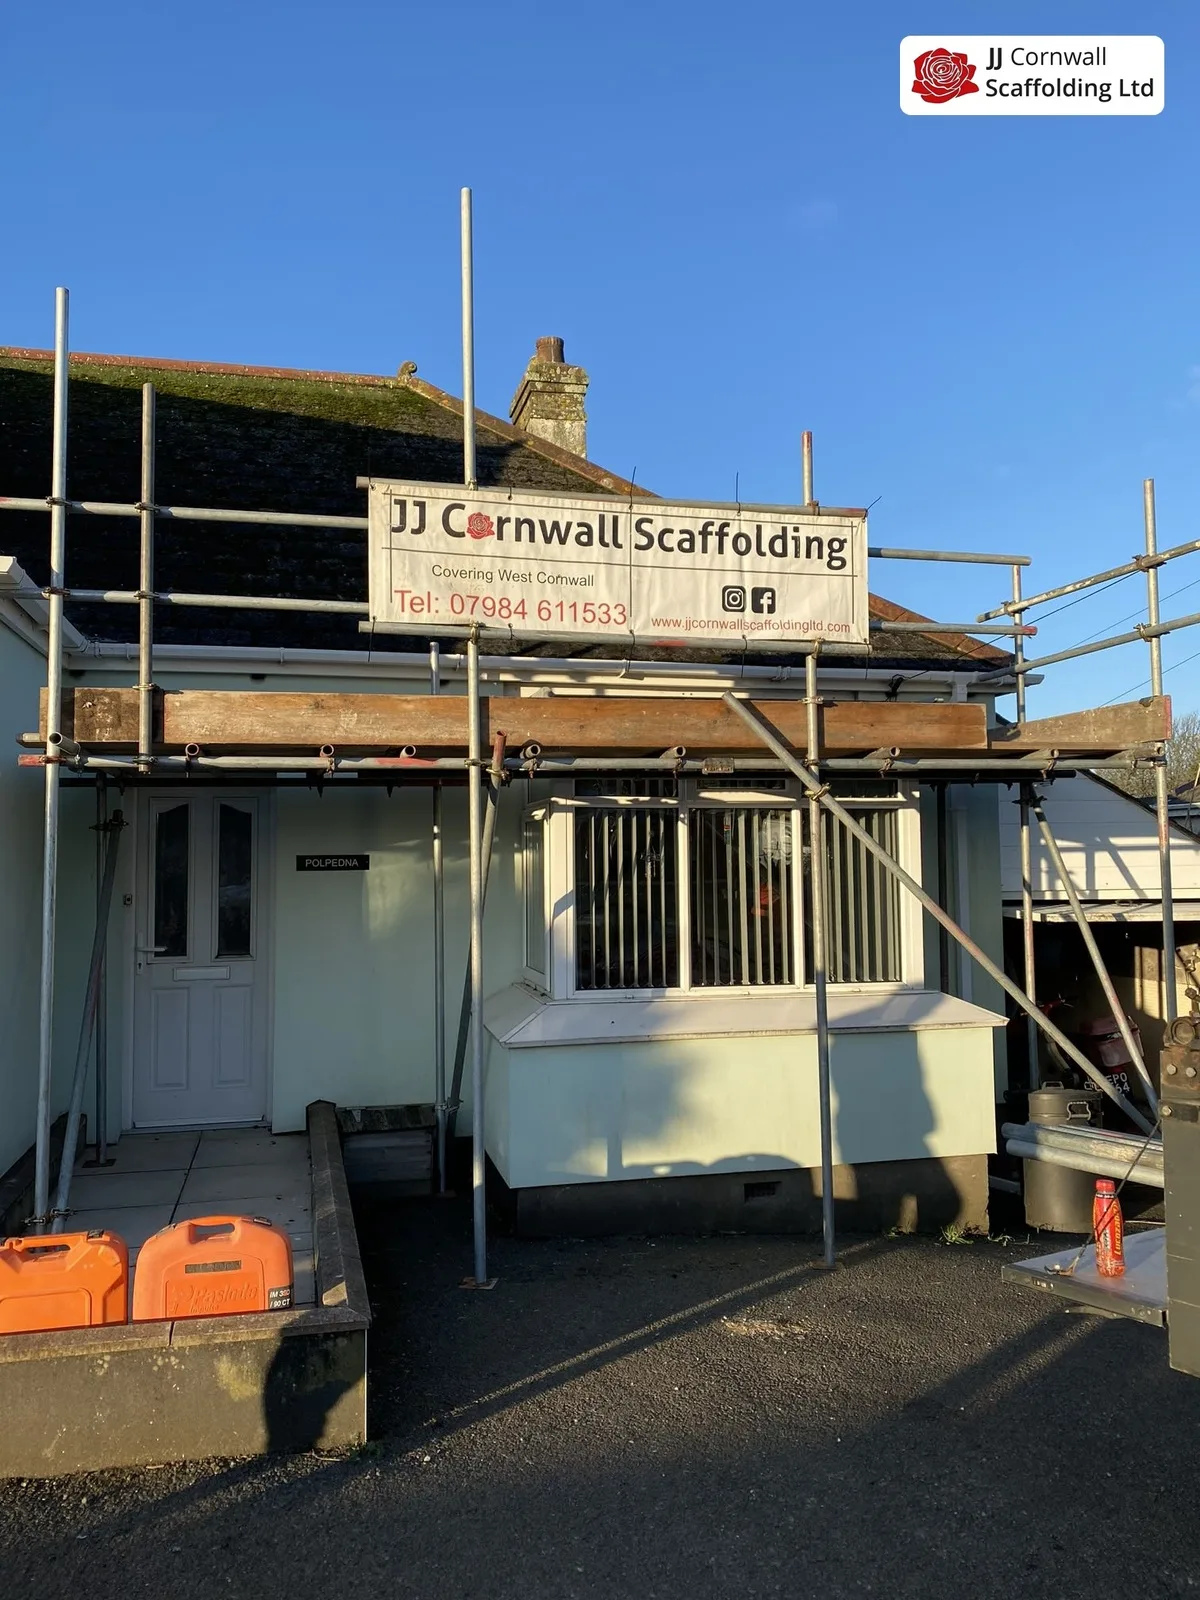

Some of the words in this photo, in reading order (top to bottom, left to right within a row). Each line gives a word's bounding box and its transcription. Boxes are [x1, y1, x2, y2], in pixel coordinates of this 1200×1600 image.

[391, 499, 426, 535] JJ
[634, 517, 847, 570] Scaffolding
[431, 564, 493, 583] Covering
[498, 568, 532, 584] West
[536, 571, 594, 587] Cornwall
[394, 589, 439, 614] Tel:
[450, 592, 528, 620] 07984
[537, 599, 627, 625] 611533
[651, 616, 850, 634] www.jjcornwallscaffoldingltd.com
[305, 858, 359, 868] POLPEDNA
